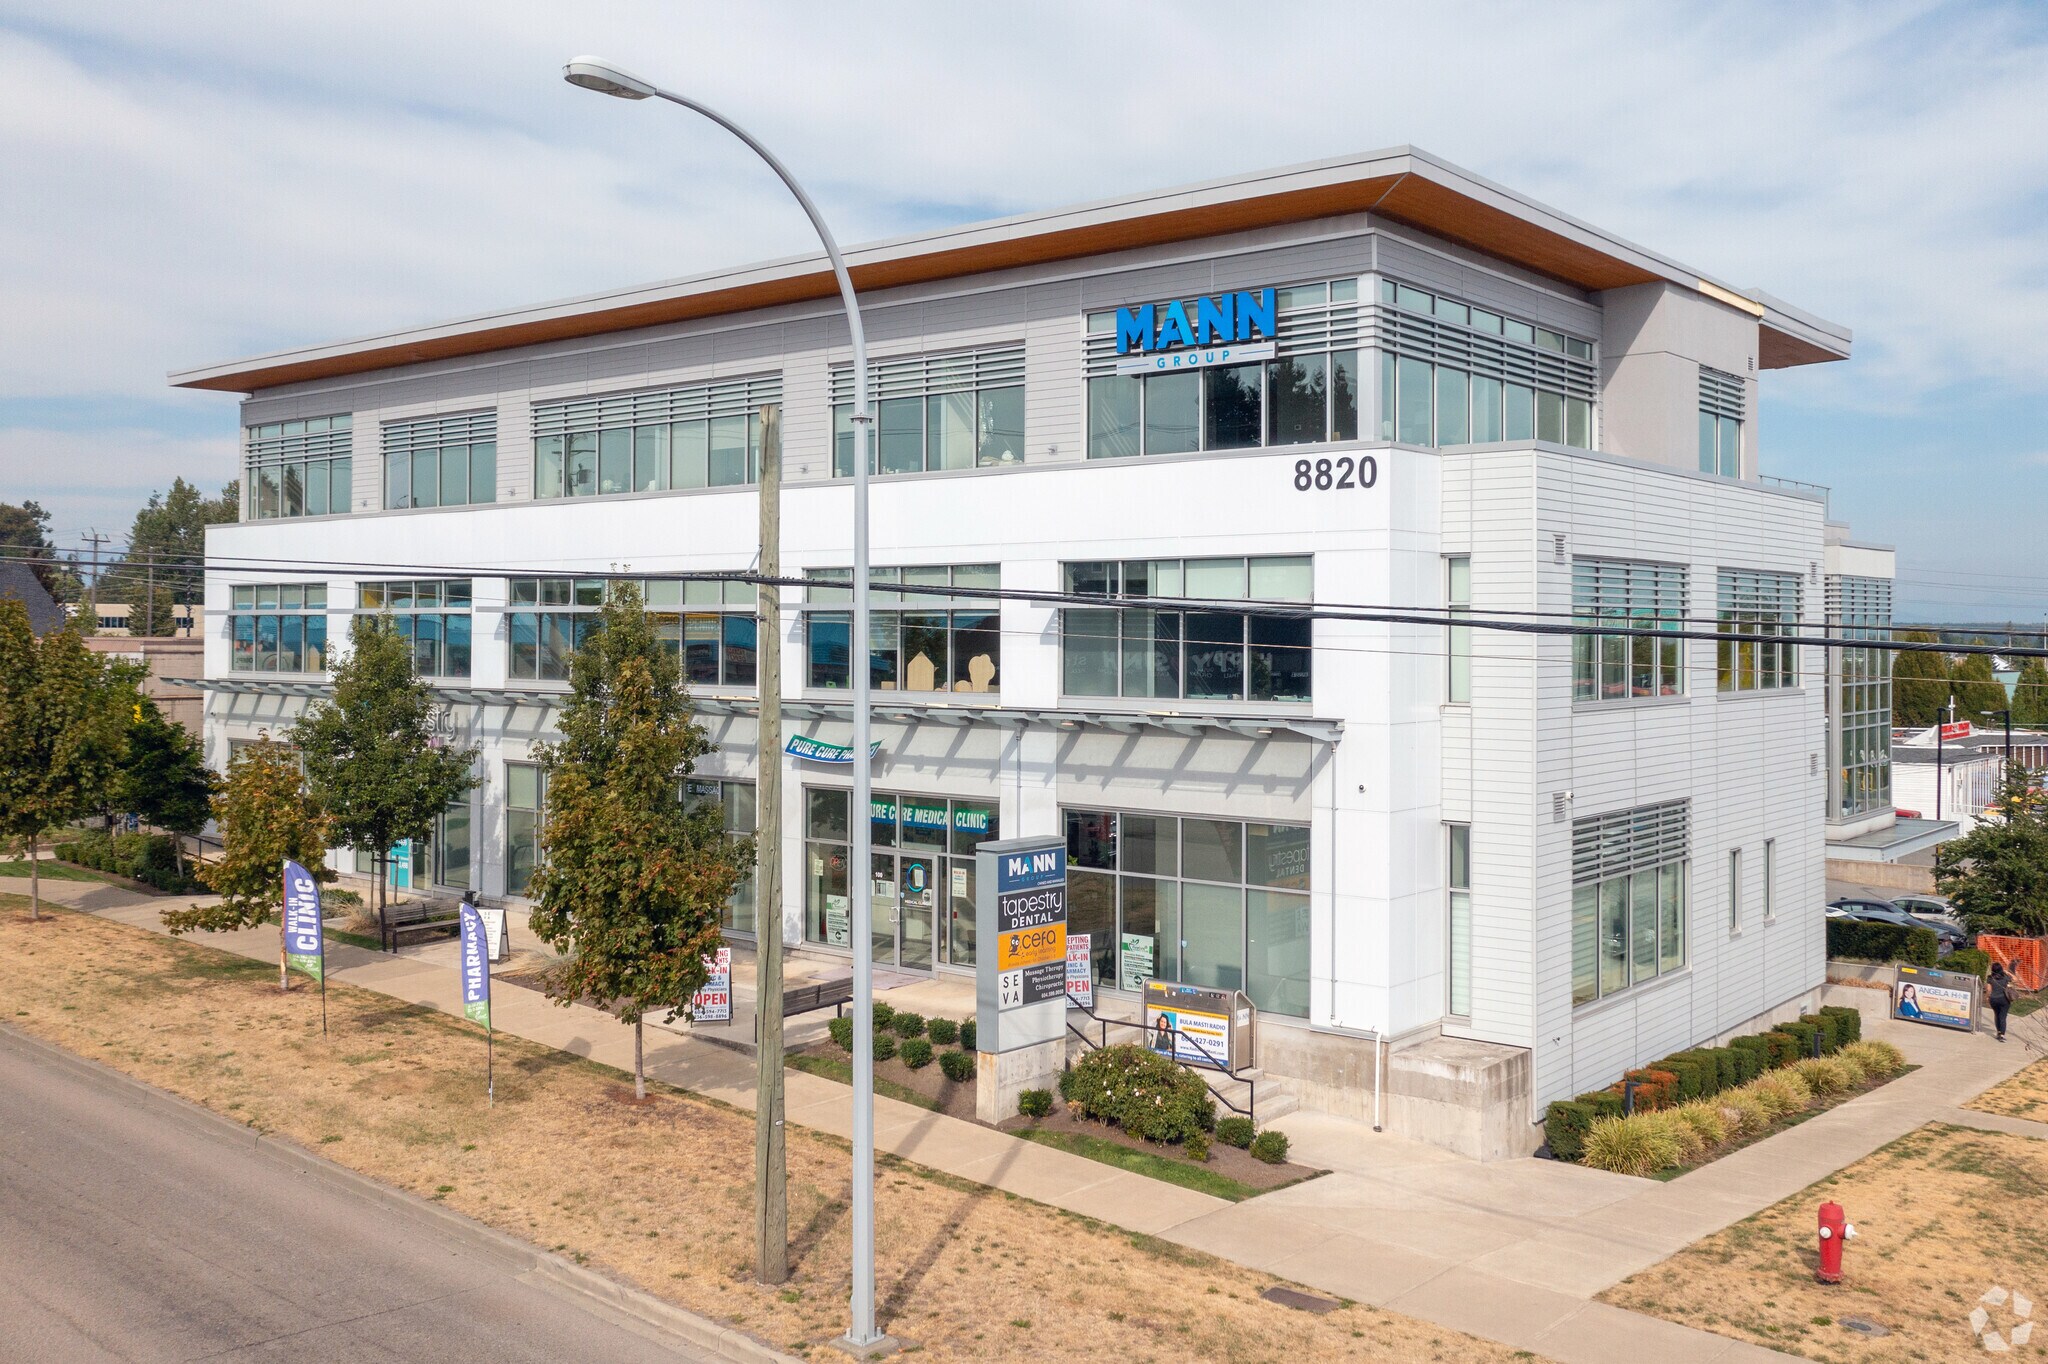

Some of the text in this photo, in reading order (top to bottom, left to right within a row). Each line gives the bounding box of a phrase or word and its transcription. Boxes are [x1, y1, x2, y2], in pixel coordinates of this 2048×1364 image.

[1116, 288, 1277, 354] MANN
[1157, 350, 1230, 369] GROUP
[1294, 455, 1378, 492] 8820
[789, 738, 817, 756] PURE
[815, 746, 840, 760] CURE
[870, 803, 986, 829] URE CRE MEDICA CLINIC
[1009, 853, 1056, 877] MANN
[294, 878, 318, 950] CLINIC
[1002, 891, 1063, 918] tapestry
[288, 897, 298, 933] WALK-IN
[1011, 912, 1053, 929] DENTAL
[1022, 930, 1056, 949] cefa
[1067, 936, 1089, 945] EPTING
[464, 912, 482, 1001] PHARMACY
[1067, 953, 1088, 962] LK-IN
[1024, 964, 1064, 977] Massage Therapy
[1031, 972, 1064, 984] Physiotherapy
[1035, 980, 1064, 991] Chiropractic
[1066, 980, 1090, 993] PEN
[1918, 986, 1949, 997] ANGELA
[694, 993, 727, 1005] OPEN
[1180, 1018, 1226, 1031] BULA MASTI RADIO
